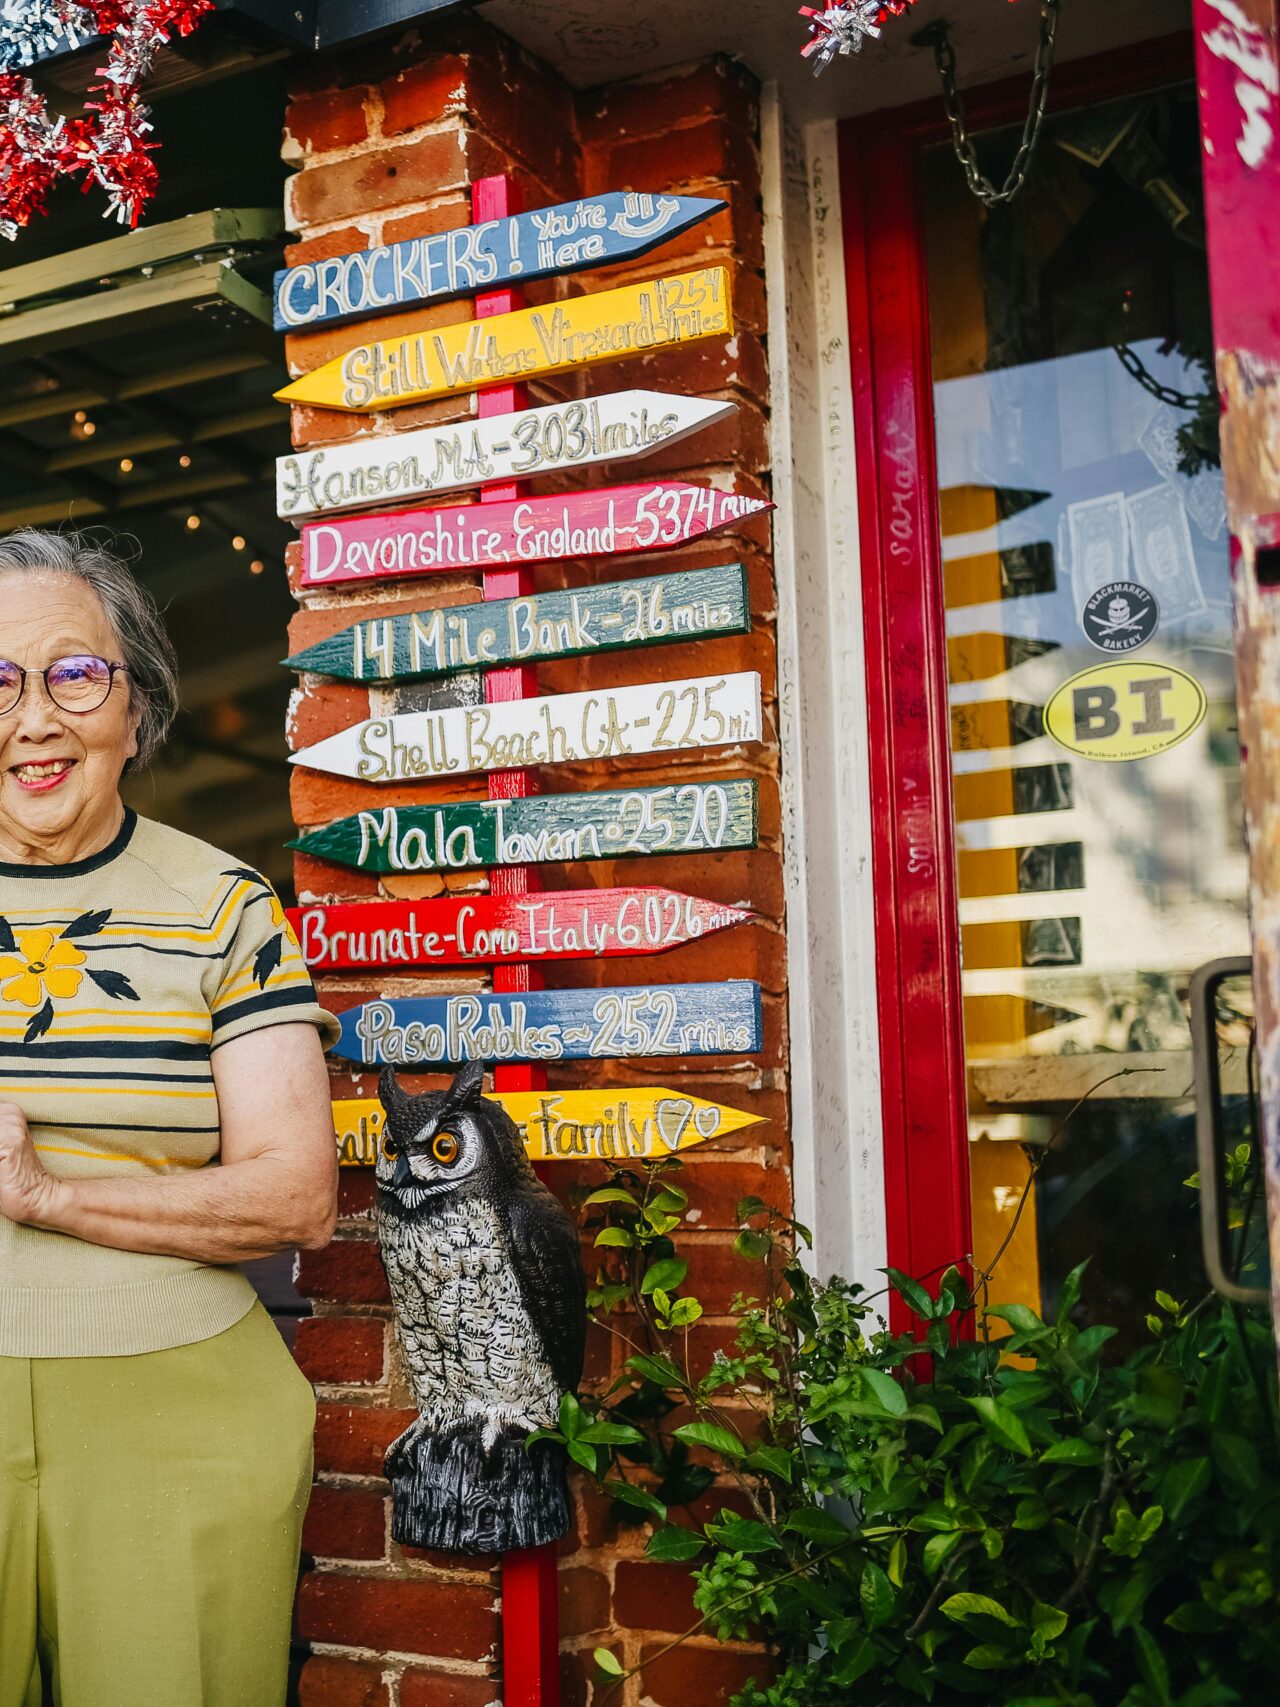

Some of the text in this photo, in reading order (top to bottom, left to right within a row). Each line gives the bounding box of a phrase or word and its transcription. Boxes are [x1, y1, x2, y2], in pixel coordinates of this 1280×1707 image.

[531, 201, 607, 240] You're
[537, 235, 606, 269] Here
[654, 268, 721, 322] 1254
[670, 310, 725, 343] miles
[341, 337, 432, 407] Still
[432, 325, 538, 388] Waters
[282, 451, 433, 511] Hanson,
[308, 513, 509, 580] Devonshire,
[719, 493, 766, 522] miles
[1088, 584, 1151, 610] BLACKMARKET
[352, 619, 394, 679] 14
[410, 609, 496, 672] Mile
[508, 597, 600, 658] Bank
[671, 599, 732, 633] miles
[1103, 633, 1142, 649] BAKERY
[356, 715, 458, 781] Shell
[581, 696, 632, 757] CA
[651, 680, 726, 749] 225
[1073, 678, 1175, 742] BI
[358, 807, 482, 871] Mala
[479, 798, 601, 865] Tavern
[708, 907, 748, 931] miles
[356, 1000, 446, 1064] Paso
[447, 995, 563, 1062] Robles
[590, 990, 682, 1057] 252
[679, 1020, 753, 1053] miles
[532, 1096, 652, 1158] Family
